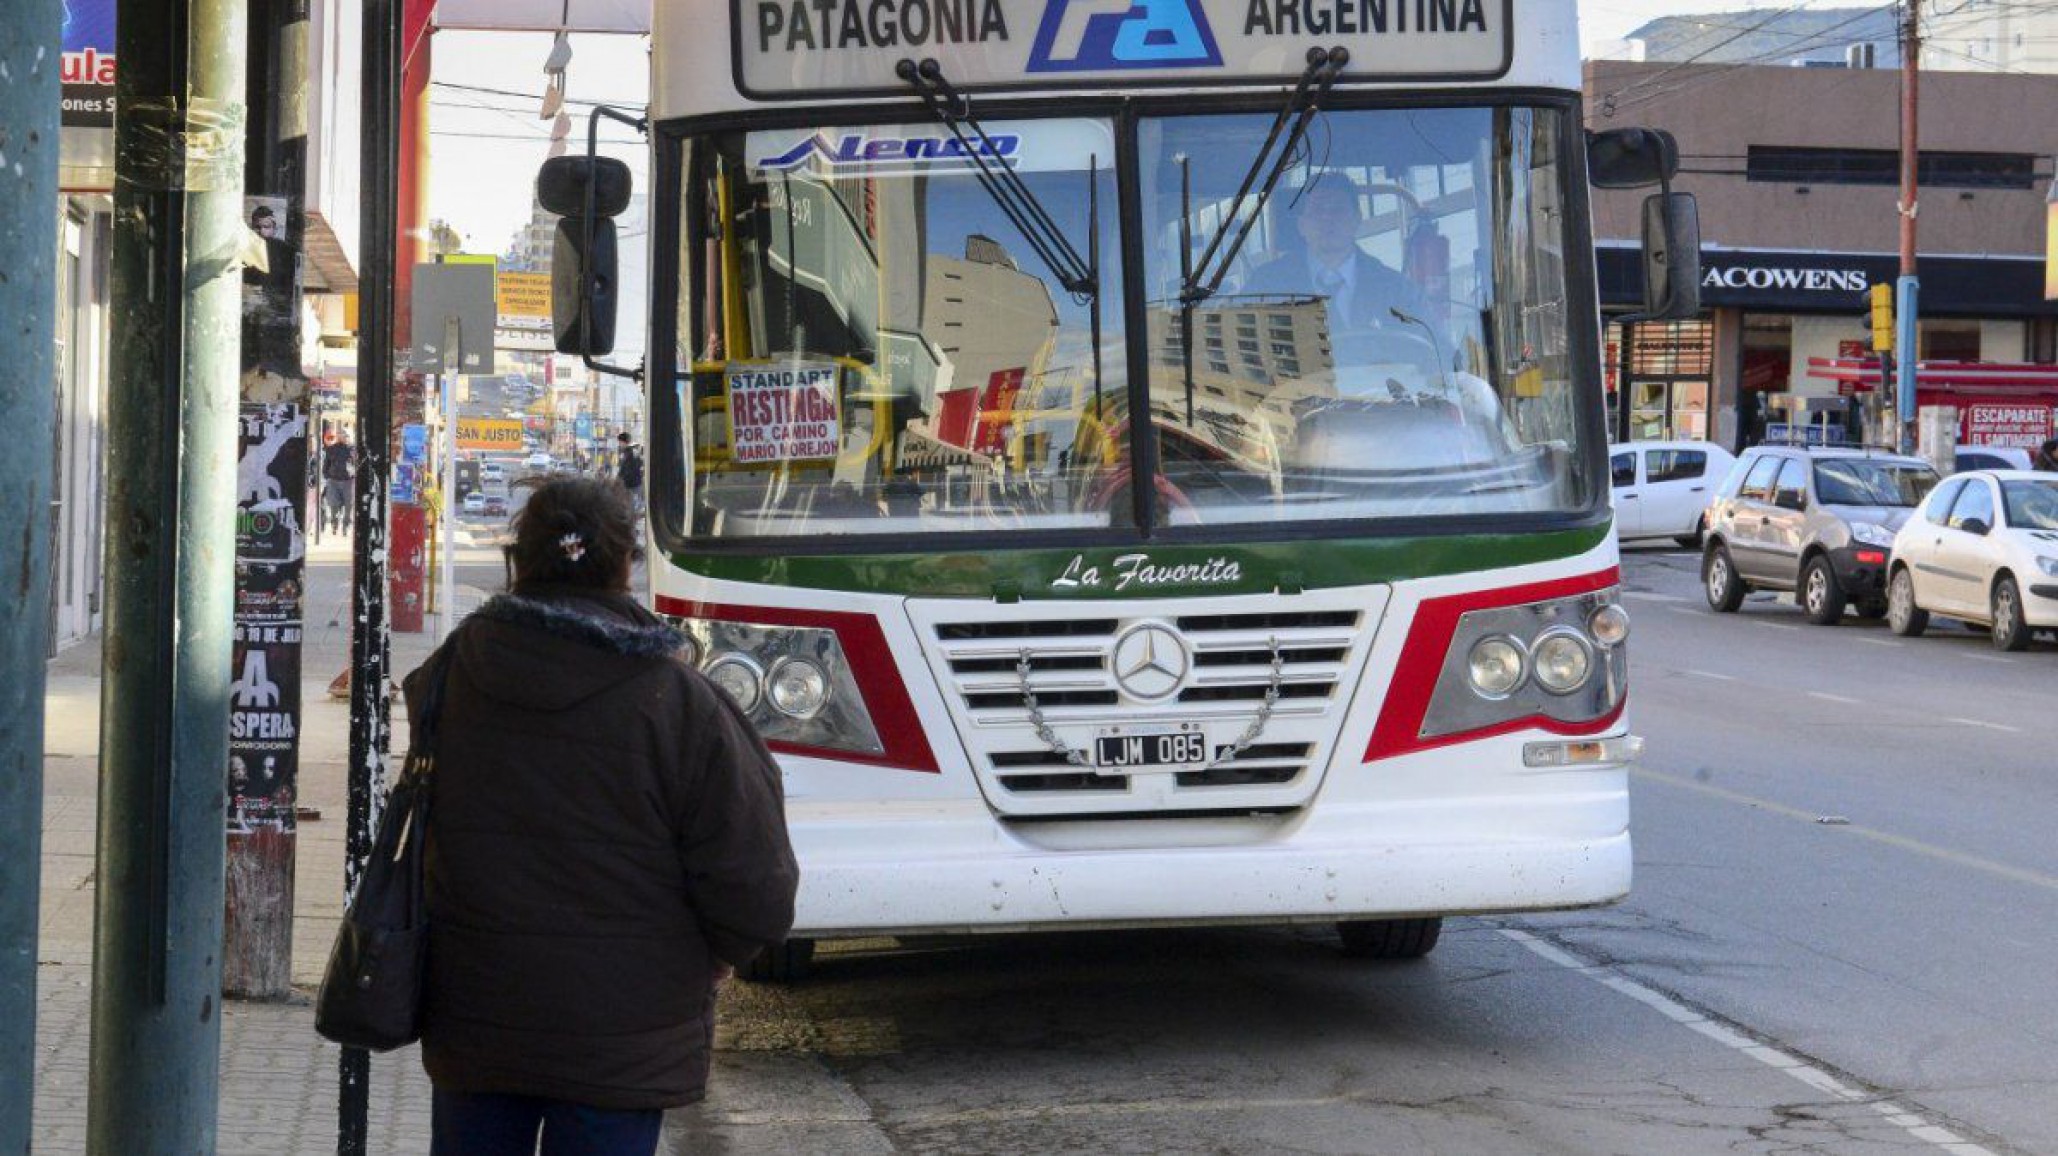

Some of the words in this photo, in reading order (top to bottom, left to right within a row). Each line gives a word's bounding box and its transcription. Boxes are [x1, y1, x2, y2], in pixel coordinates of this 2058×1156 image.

[757, 0, 1009, 52] PATAGONIA
[1244, 0, 1487, 35] ARGENTINA
[62, 98, 102, 112] ones
[1701, 266, 1867, 291] ACOWENS
[731, 369, 832, 389] STANDART
[732, 386, 837, 426] RESTINGA
[456, 427, 479, 440] SAN
[481, 428, 521, 442] JUSTO
[735, 426, 763, 442] POR
[771, 423, 828, 441] CAMINO
[737, 443, 776, 460] MARIO
[1052, 554, 1100, 586] La
[1113, 553, 1241, 591] Favorita
[229, 711, 296, 739] SPERA
[1099, 736, 1143, 767] LJM
[1158, 732, 1203, 763] 085
